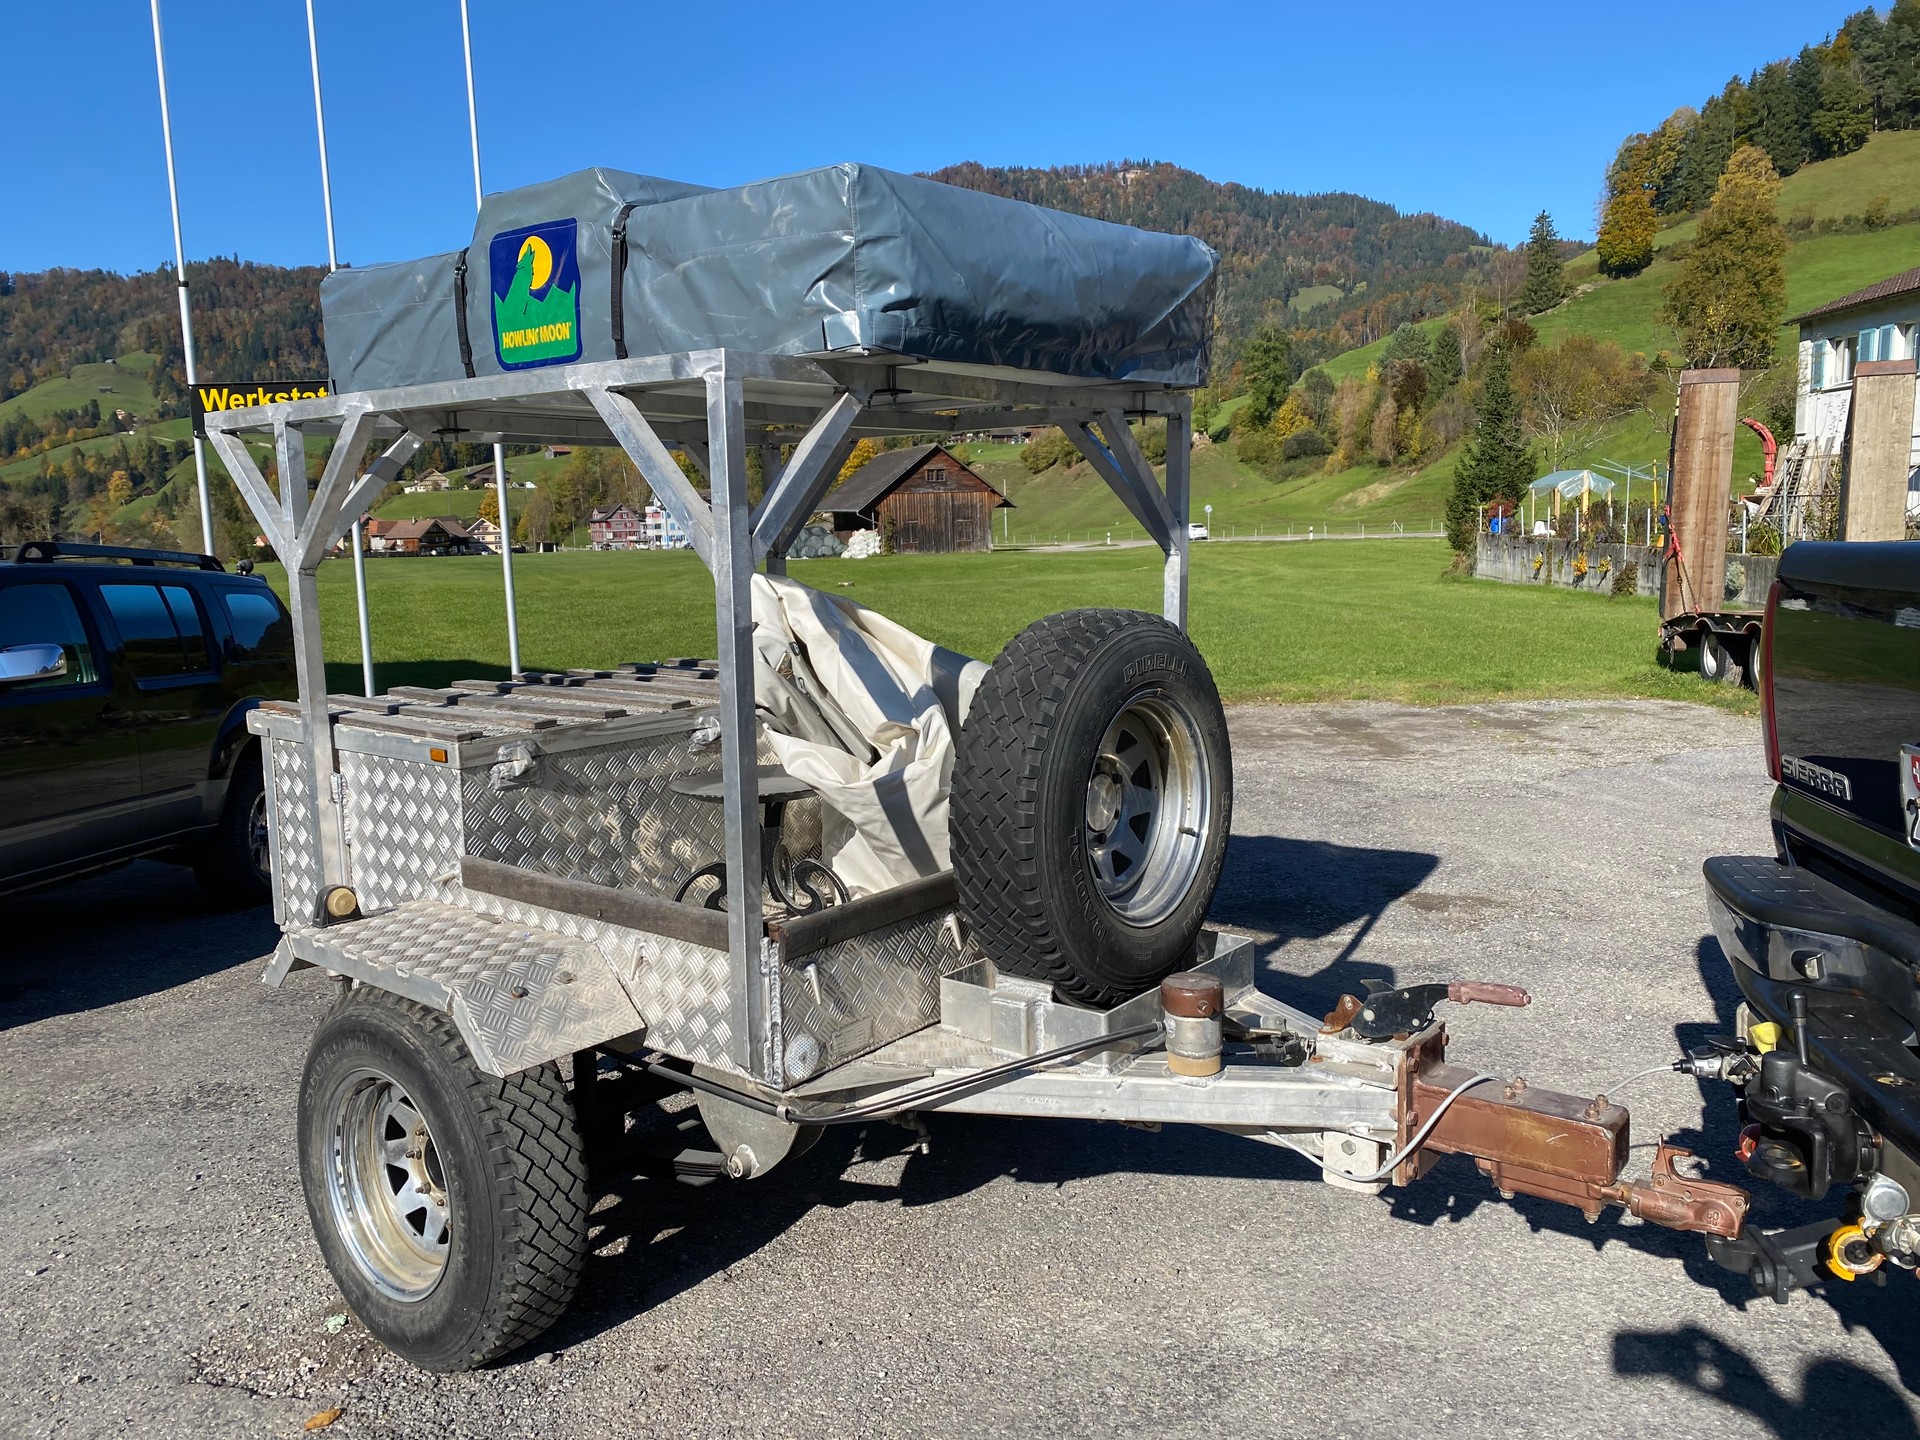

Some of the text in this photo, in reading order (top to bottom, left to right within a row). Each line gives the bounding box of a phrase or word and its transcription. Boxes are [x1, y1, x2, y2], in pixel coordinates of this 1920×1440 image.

[540, 321, 570, 343] MOON
[1123, 652, 1188, 684] PIRELLI
[1781, 753, 1853, 801] SIERRA
[1067, 825, 1108, 944] RADIAL
[1183, 791, 1232, 937] SCORPION
